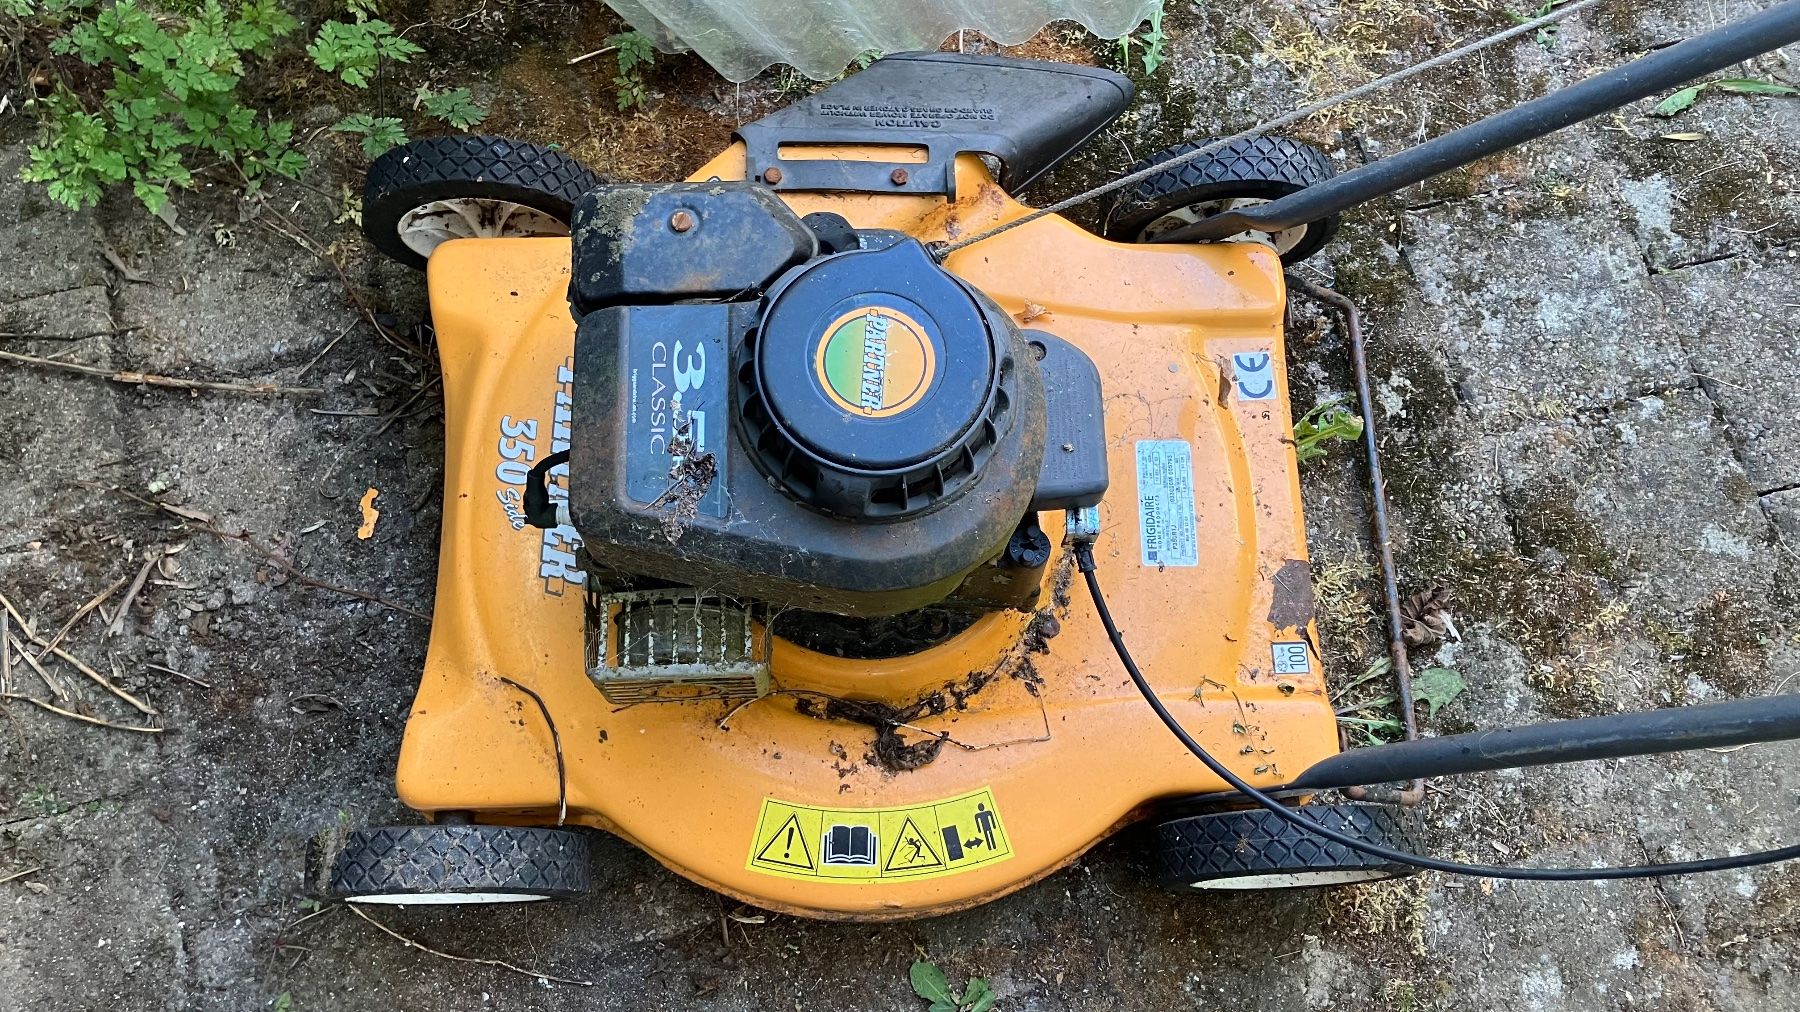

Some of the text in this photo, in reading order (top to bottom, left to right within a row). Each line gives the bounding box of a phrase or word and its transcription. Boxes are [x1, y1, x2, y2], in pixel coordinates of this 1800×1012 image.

[874, 119, 942, 129] CAUTION
[861, 314, 887, 410] PARTNER
[650, 341, 667, 455] CLASSIC
[496, 415, 538, 486] 350
[495, 487, 529, 532] Side
[1144, 496, 1157, 549] FRIGIDAIRE
[1287, 646, 1306, 670] 100
